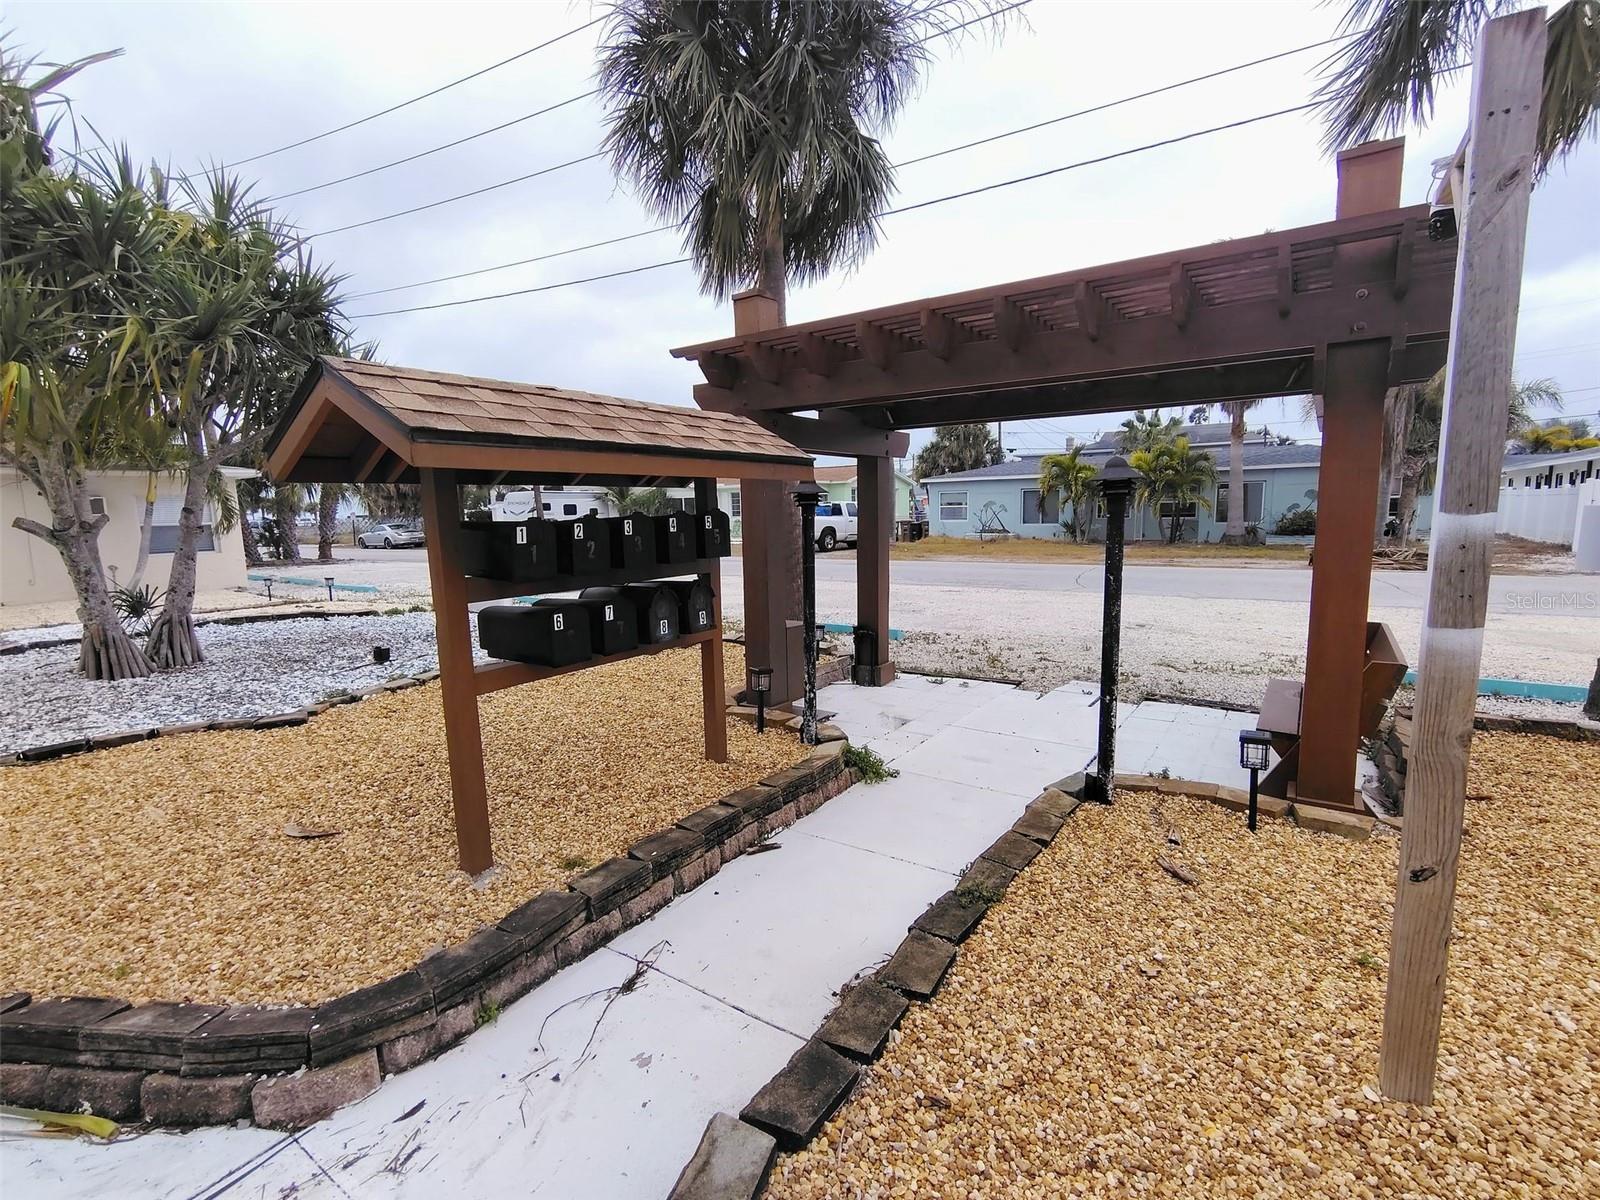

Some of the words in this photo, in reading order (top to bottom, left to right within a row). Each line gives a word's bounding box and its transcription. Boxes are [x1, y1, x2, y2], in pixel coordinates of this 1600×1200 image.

[625, 521, 632, 534] 3
[669, 519, 676, 532] 4
[705, 517, 711, 529] 5
[575, 524, 583, 538] 2
[713, 528, 720, 544] 5
[586, 541, 595, 558] 2
[634, 535, 642, 552] 3
[606, 606, 613, 620] 7
[699, 611, 706, 624] 9
[555, 615, 562, 630] 6
[661, 620, 667, 633] 8
